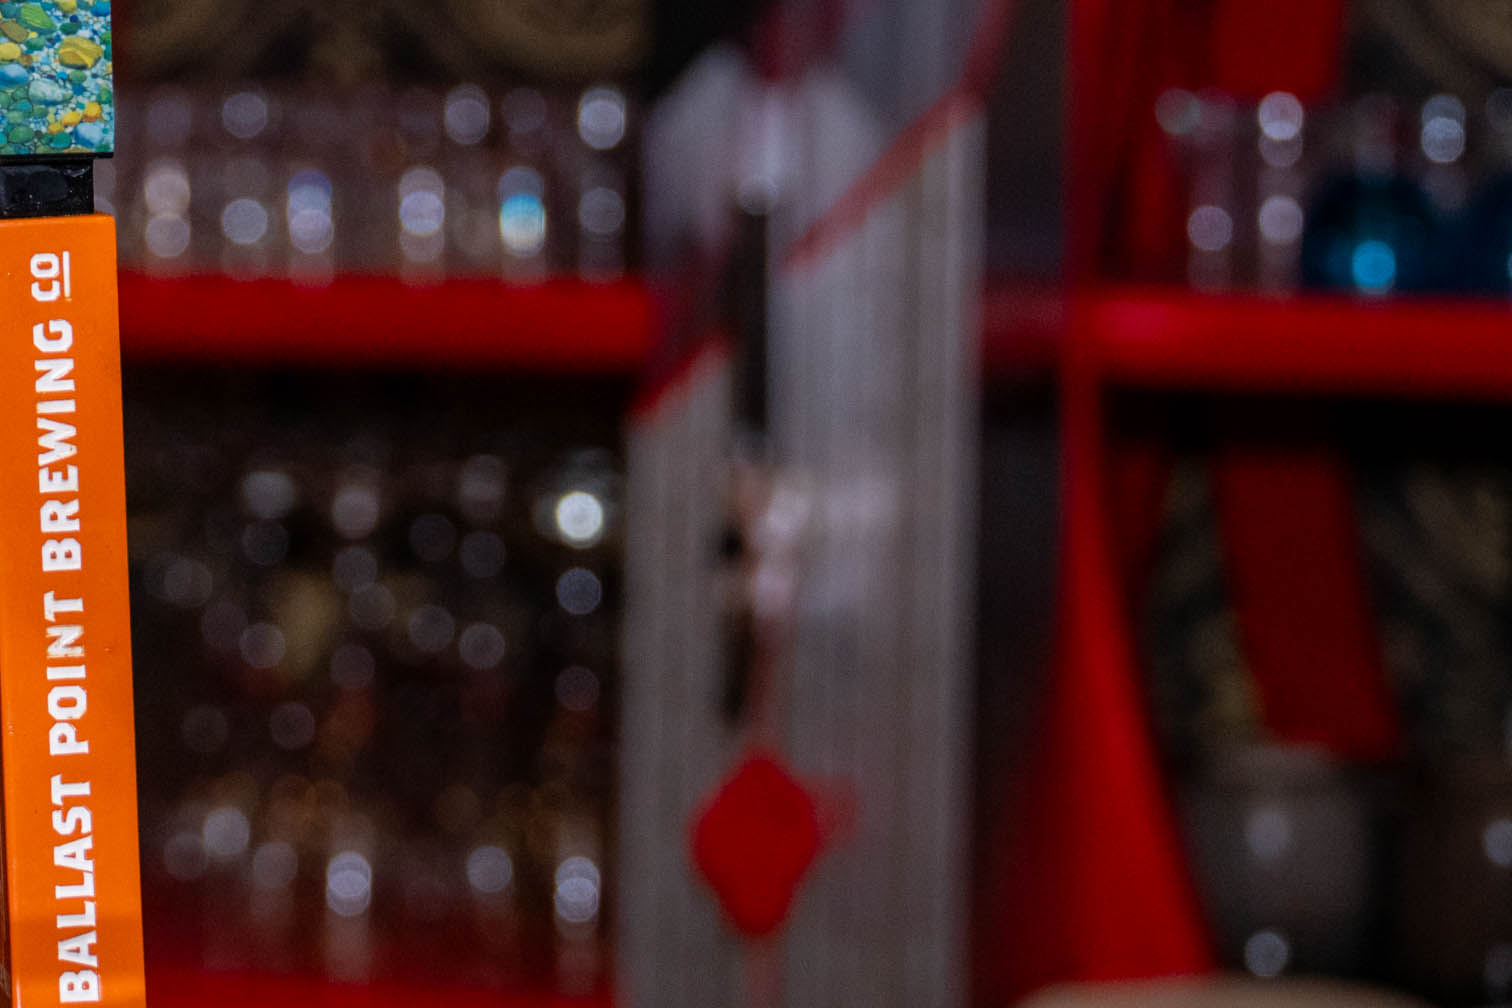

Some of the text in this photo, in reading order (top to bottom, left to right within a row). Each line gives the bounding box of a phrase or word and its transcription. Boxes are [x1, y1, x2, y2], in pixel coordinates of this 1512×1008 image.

[29, 252, 102, 1004] BALLAST POINT BREWING CO
